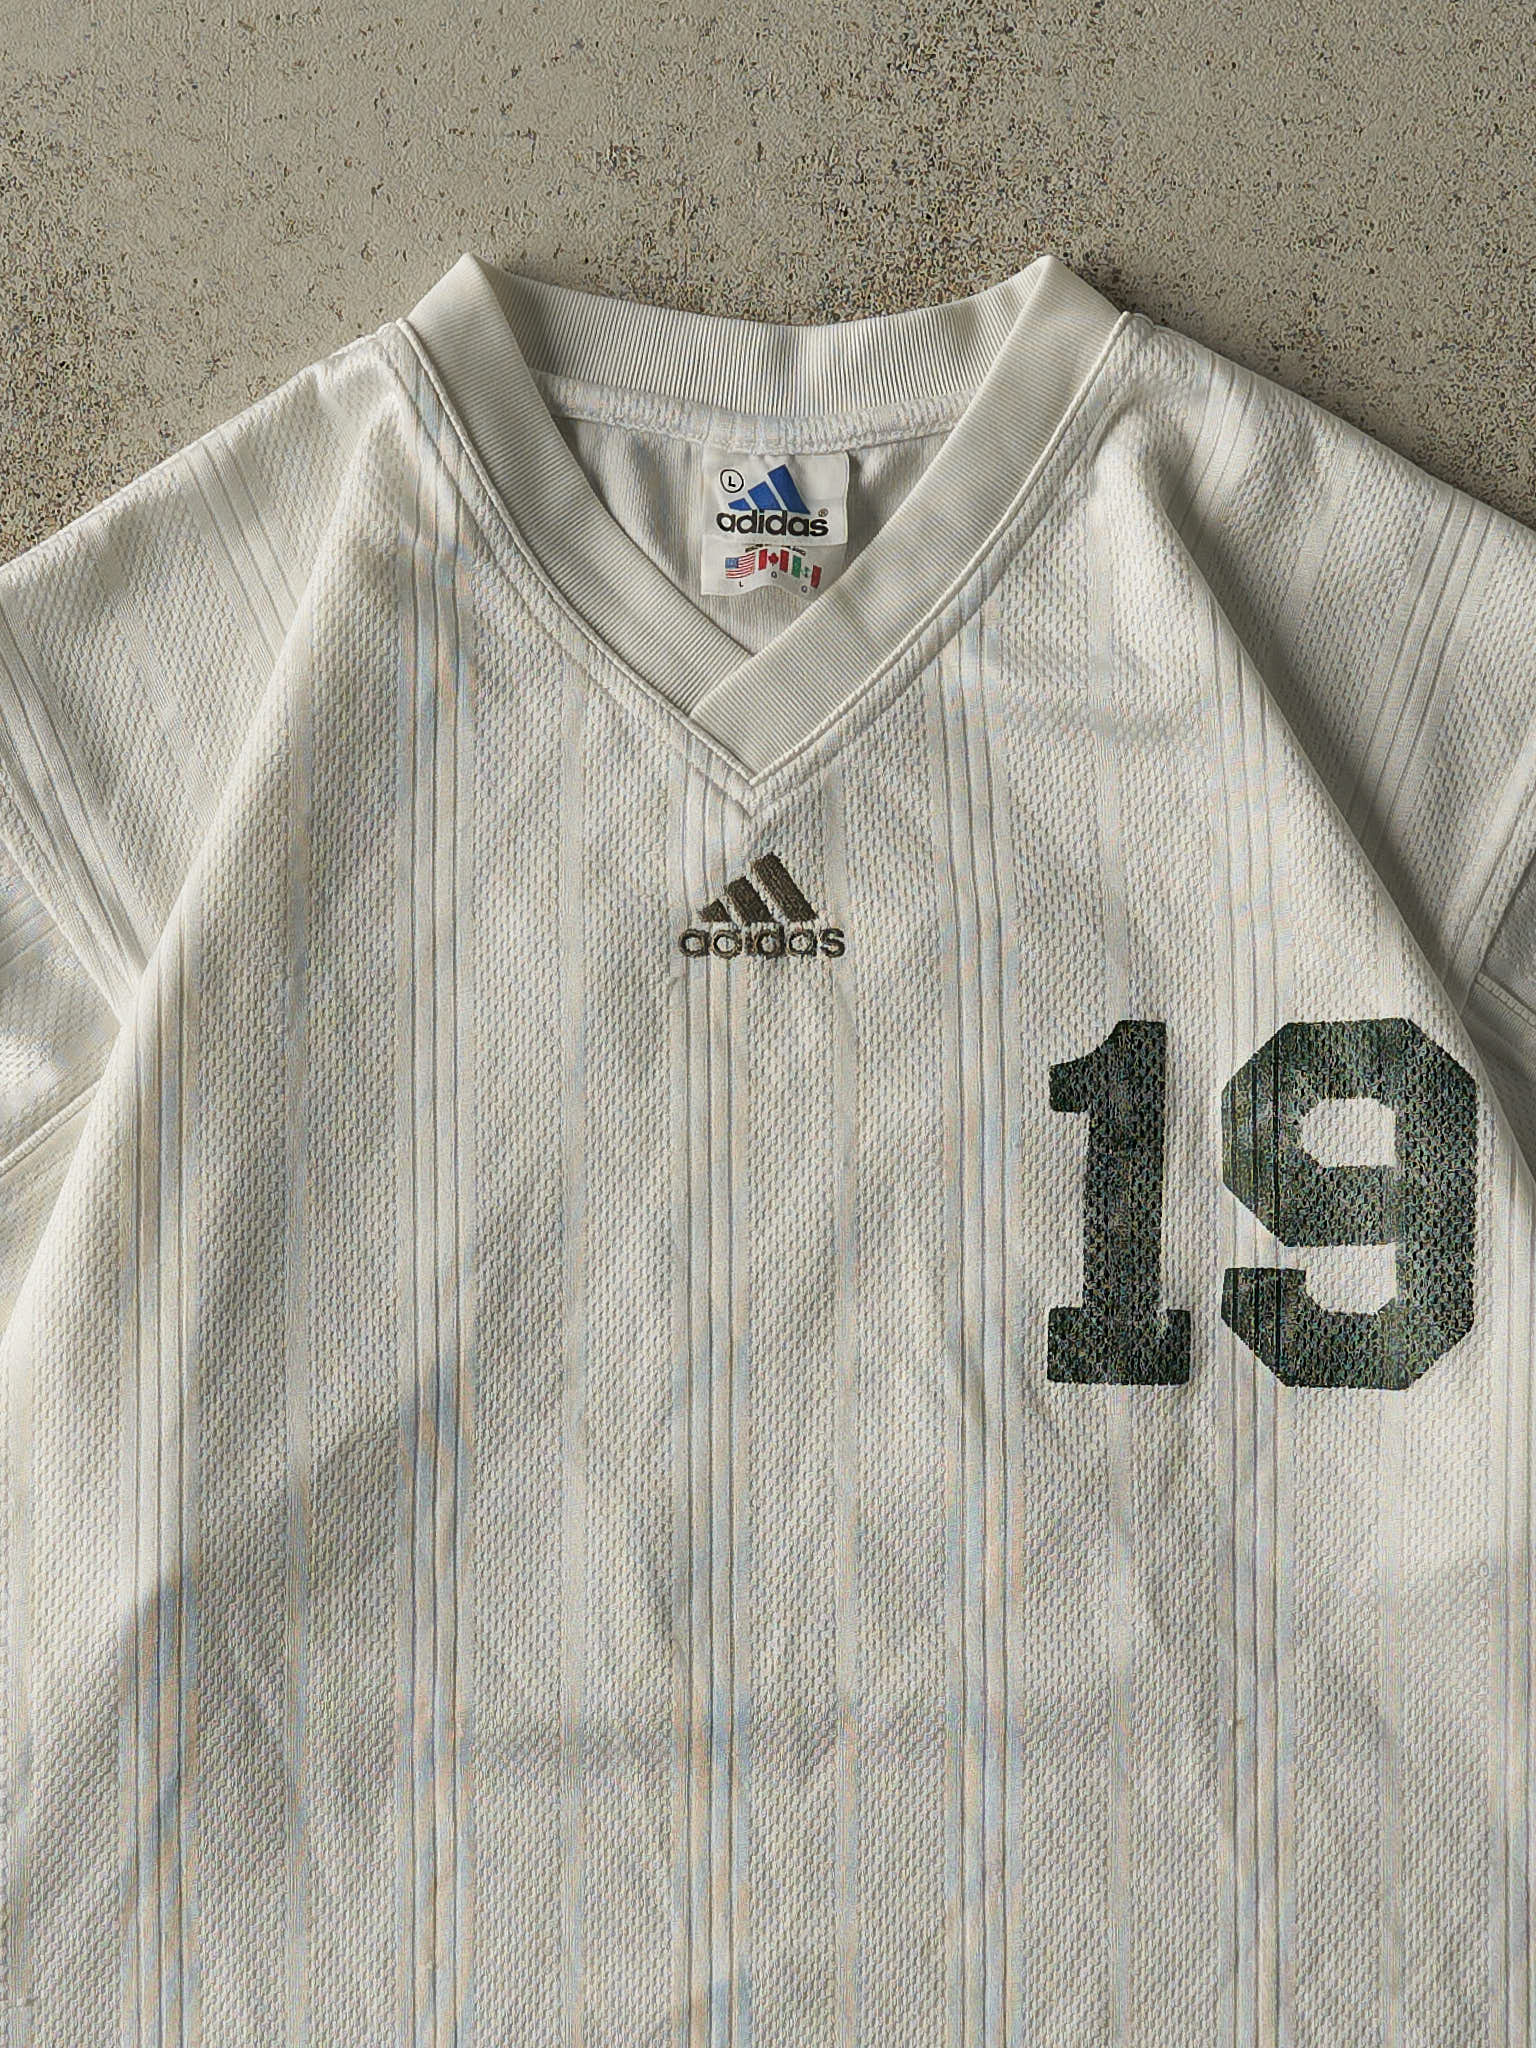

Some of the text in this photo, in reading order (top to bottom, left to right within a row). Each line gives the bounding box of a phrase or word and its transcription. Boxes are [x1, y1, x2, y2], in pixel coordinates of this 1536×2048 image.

[716, 509, 829, 537] adidas
[679, 924, 846, 959] adidas
[1047, 1017, 1479, 1390] 19
